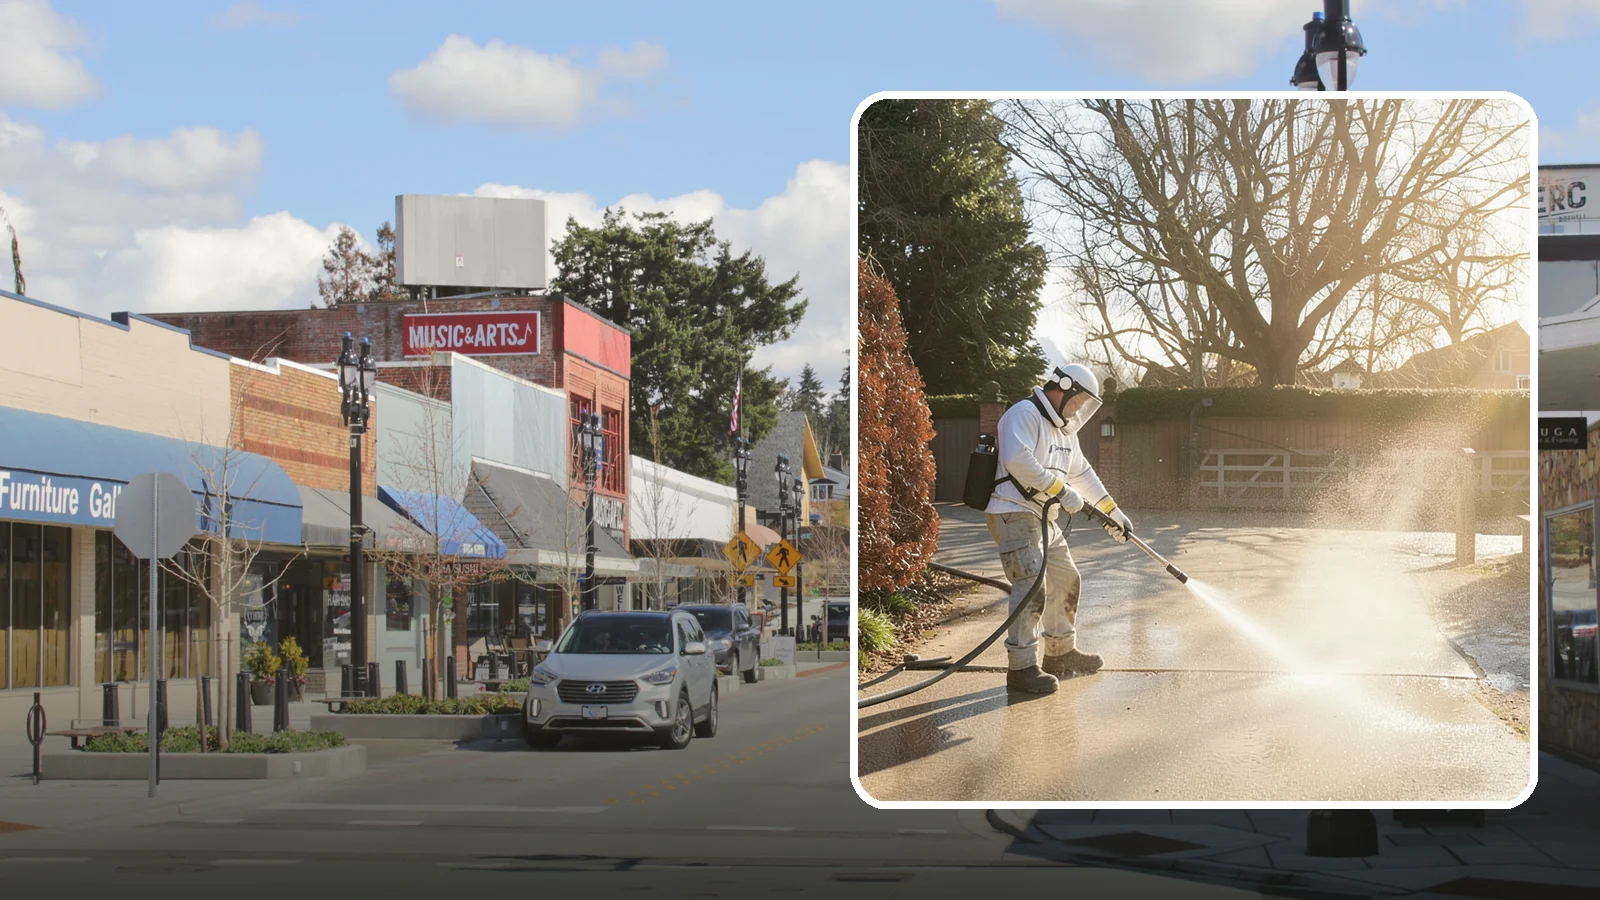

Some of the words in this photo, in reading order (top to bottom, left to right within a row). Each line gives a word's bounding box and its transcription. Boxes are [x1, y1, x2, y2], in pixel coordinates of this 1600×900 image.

[1538, 182, 1586, 213] ERC
[1540, 428, 1577, 436] UGA
[0, 471, 79, 515] Furniture
[89, 482, 122, 519] Gal
